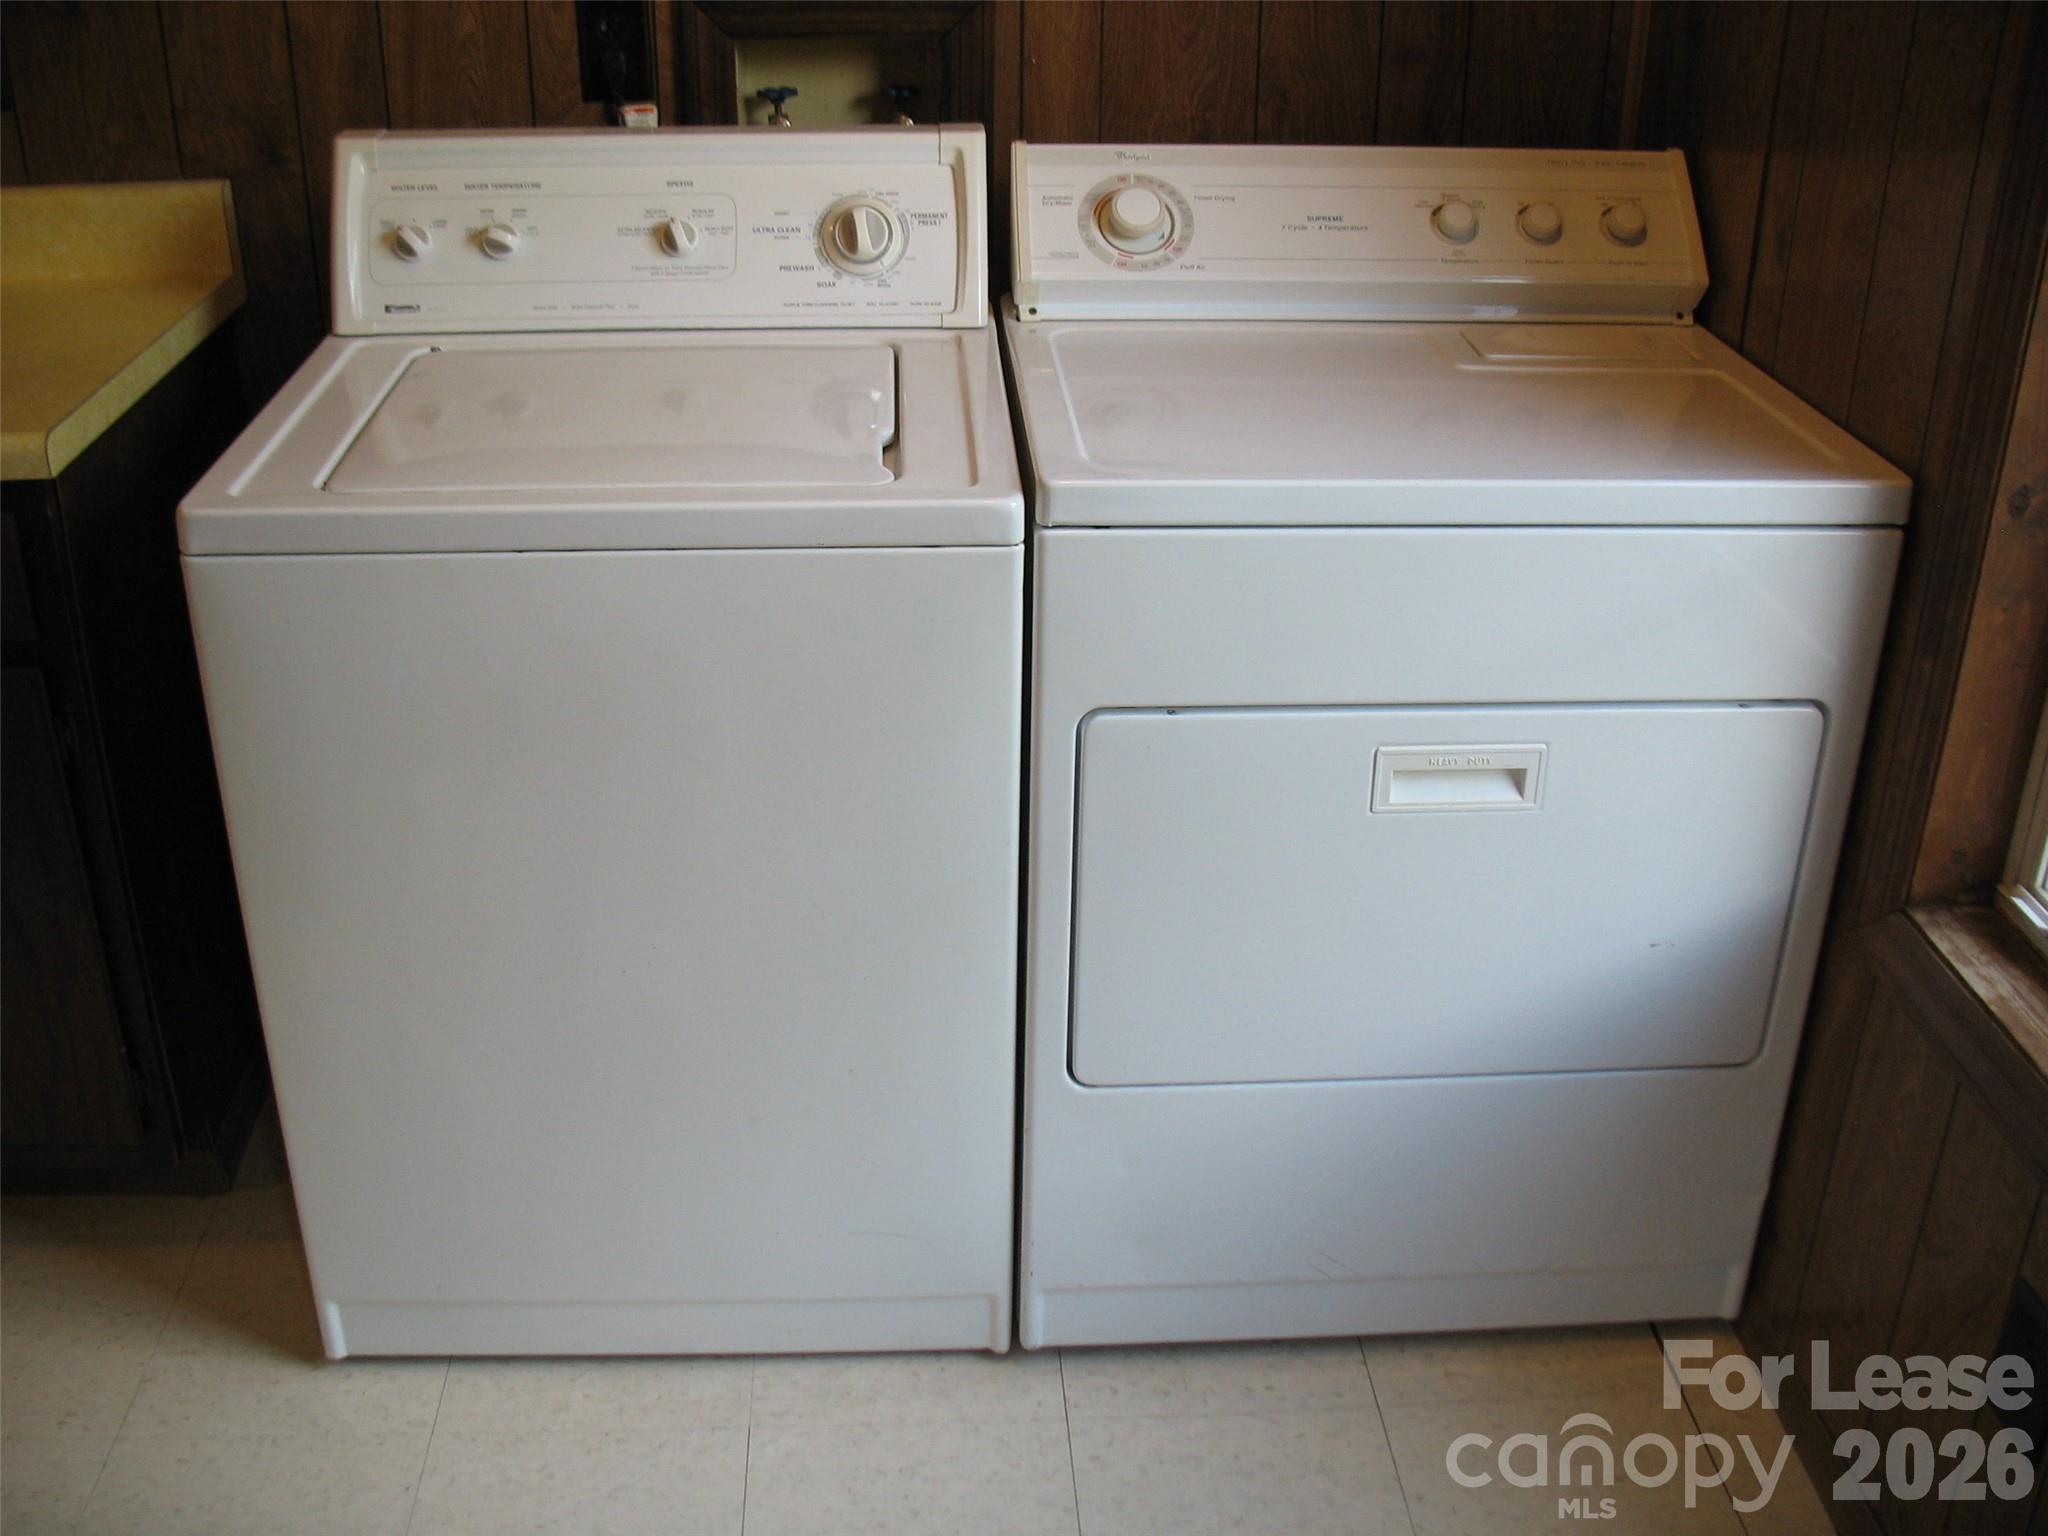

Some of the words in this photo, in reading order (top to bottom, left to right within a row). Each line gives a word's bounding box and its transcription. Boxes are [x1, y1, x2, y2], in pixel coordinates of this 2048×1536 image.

[416, 183, 438, 191] LEVEL
[1428, 757, 1458, 767] HEAVY
[1467, 756, 1491, 766] DUTY
